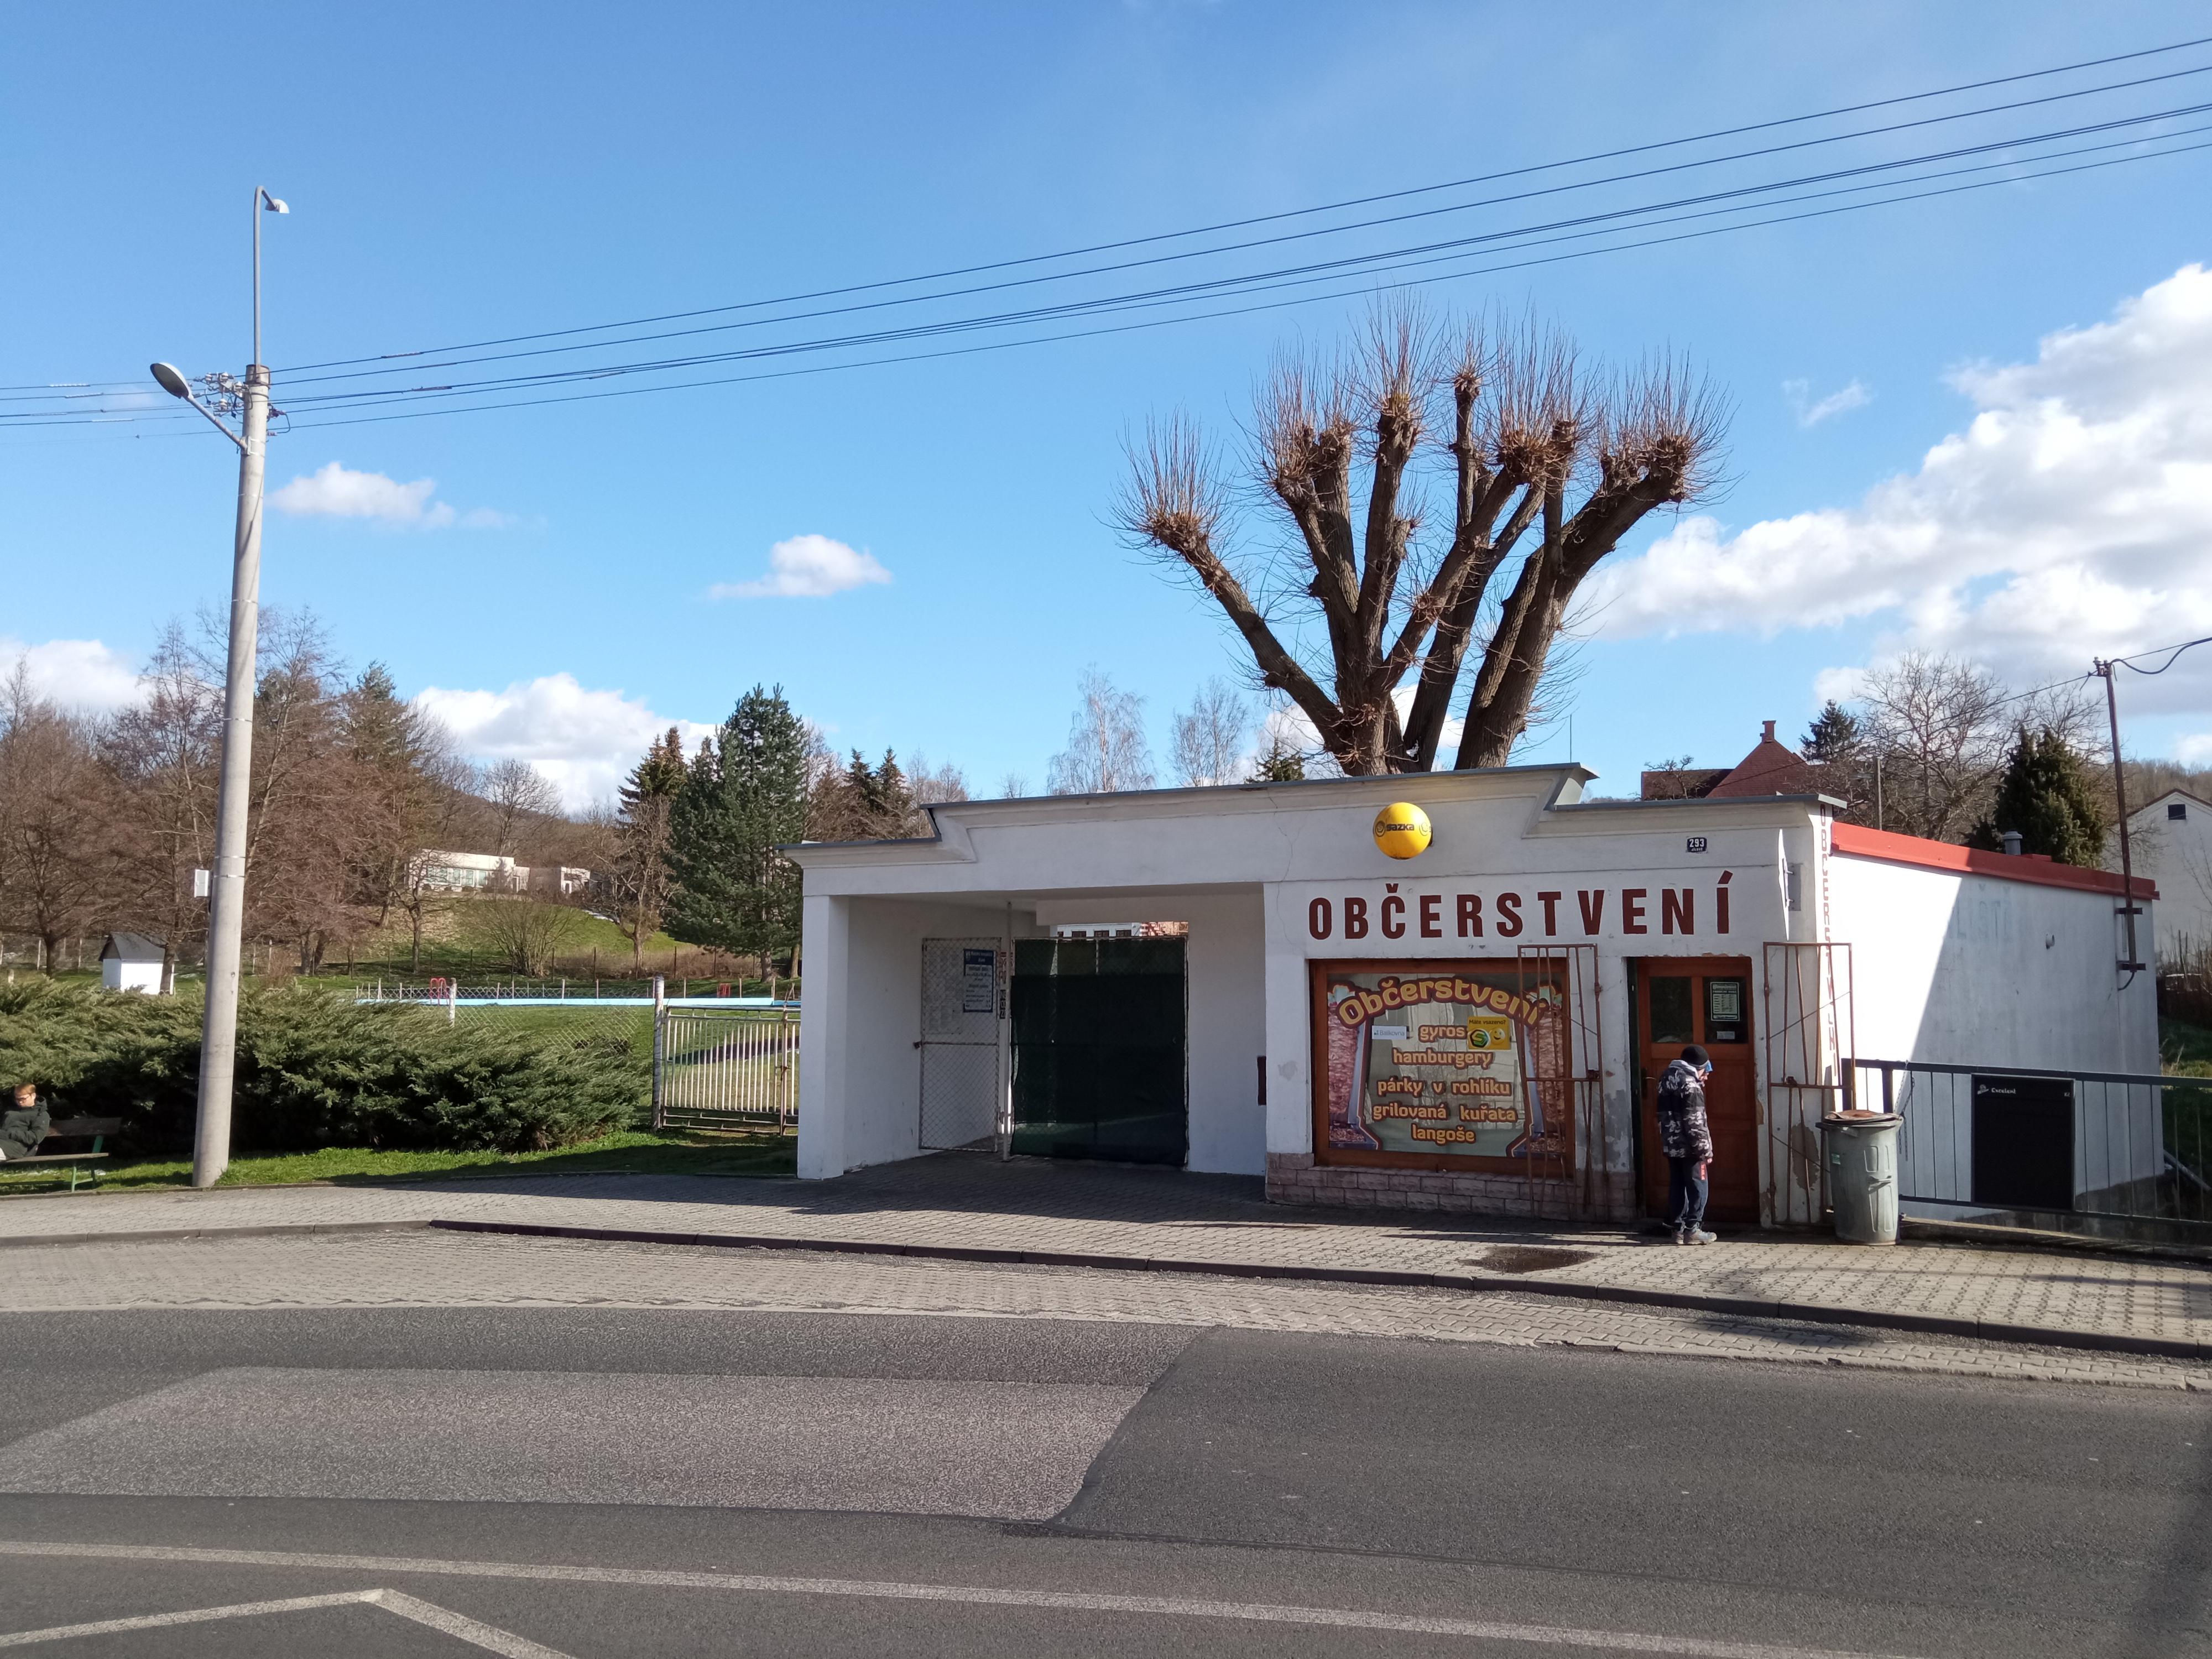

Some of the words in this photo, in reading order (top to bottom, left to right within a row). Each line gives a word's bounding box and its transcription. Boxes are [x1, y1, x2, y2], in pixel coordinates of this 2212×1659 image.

[1689, 838, 1704, 847] 293
[1308, 870, 1733, 940] OBČERSTVENÍ
[1339, 978, 1546, 1025] Občerstvení
[1419, 1026, 1465, 1041] gyros
[1392, 1048, 1493, 1068] hamburgery
[1377, 1078, 1423, 1096] párky
[1433, 1082, 1444, 1093] v
[1452, 1078, 1511, 1095] rohlíku
[1373, 1102, 1447, 1120] grilovaná
[1460, 1105, 1517, 1121] kuřata
[1412, 1124, 1475, 1144] langoše
